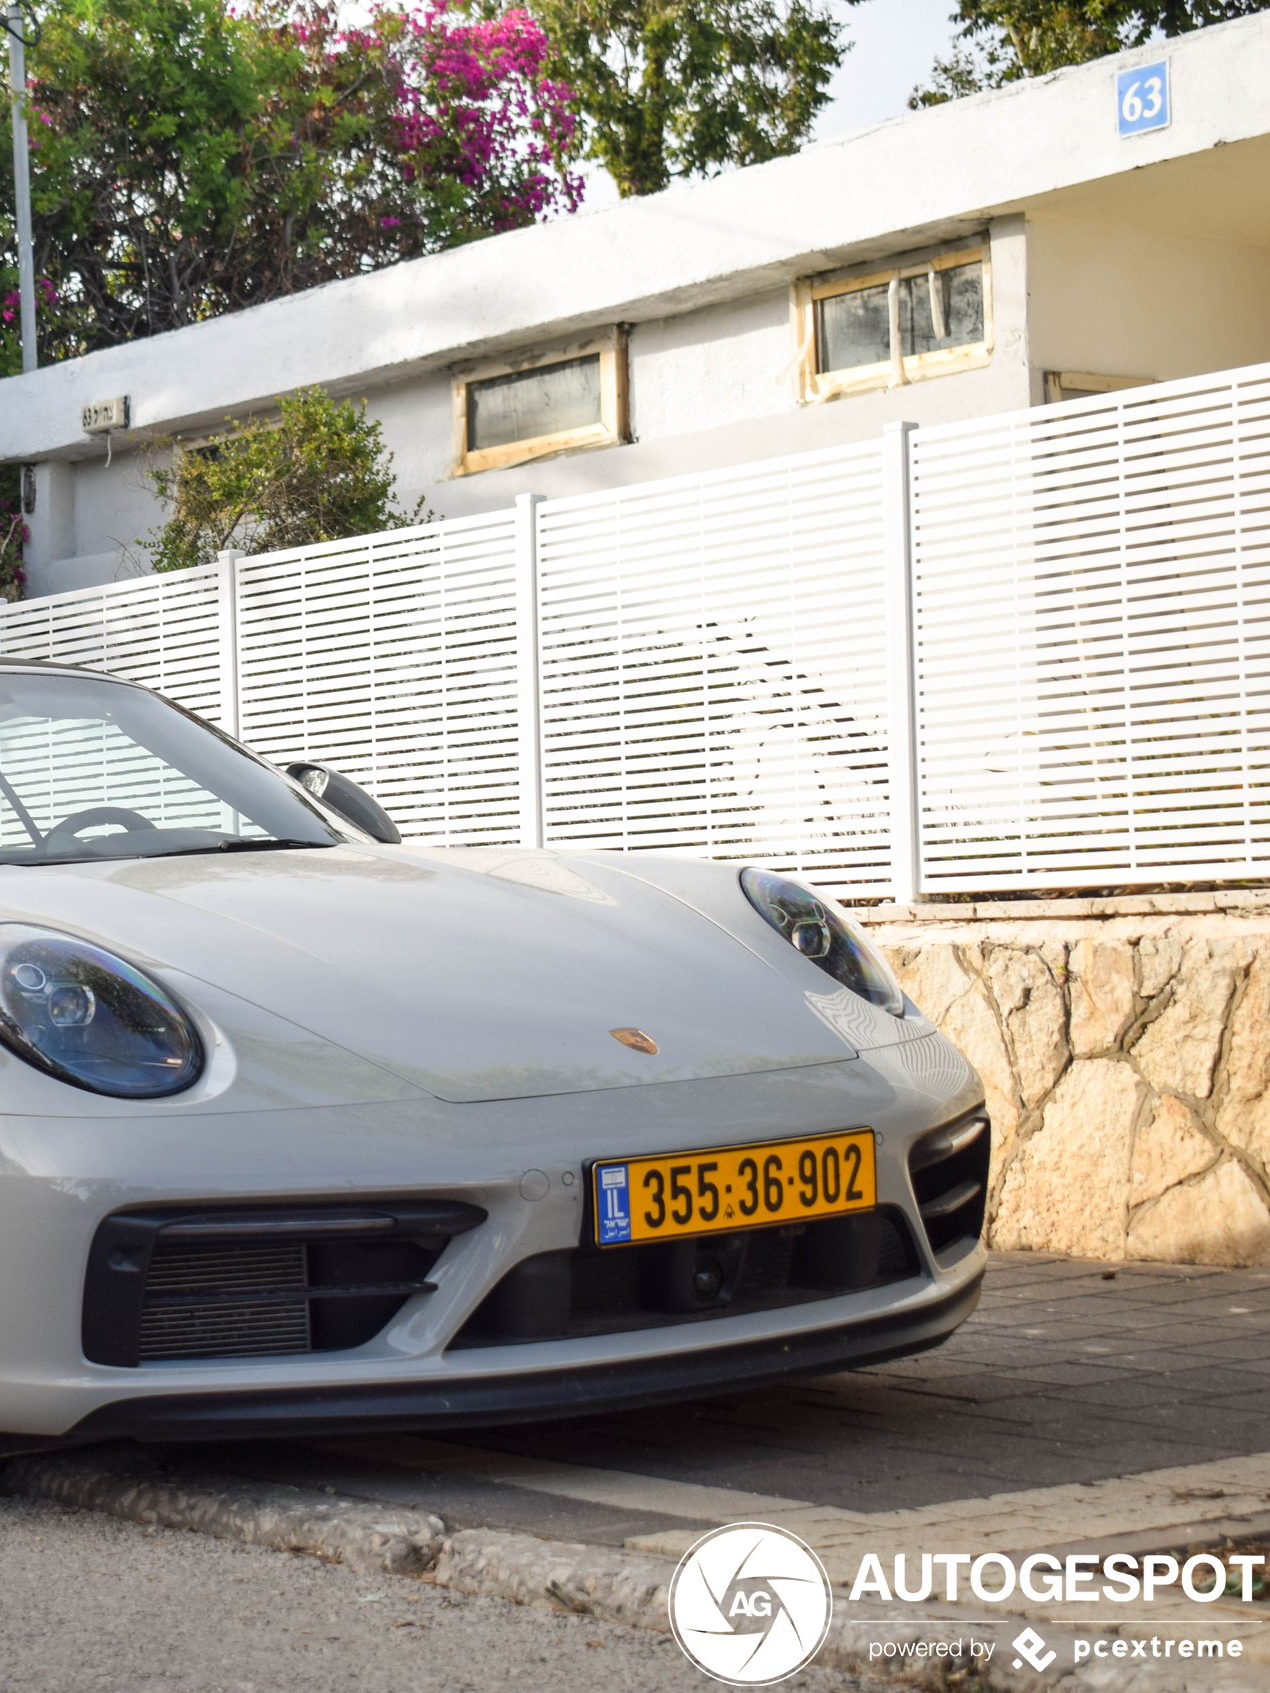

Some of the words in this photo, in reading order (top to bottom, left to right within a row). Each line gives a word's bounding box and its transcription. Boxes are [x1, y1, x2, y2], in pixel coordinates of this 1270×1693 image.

[1122, 77, 1162, 122] 63
[82, 408, 92, 428] 63
[607, 1189, 624, 1218] IL
